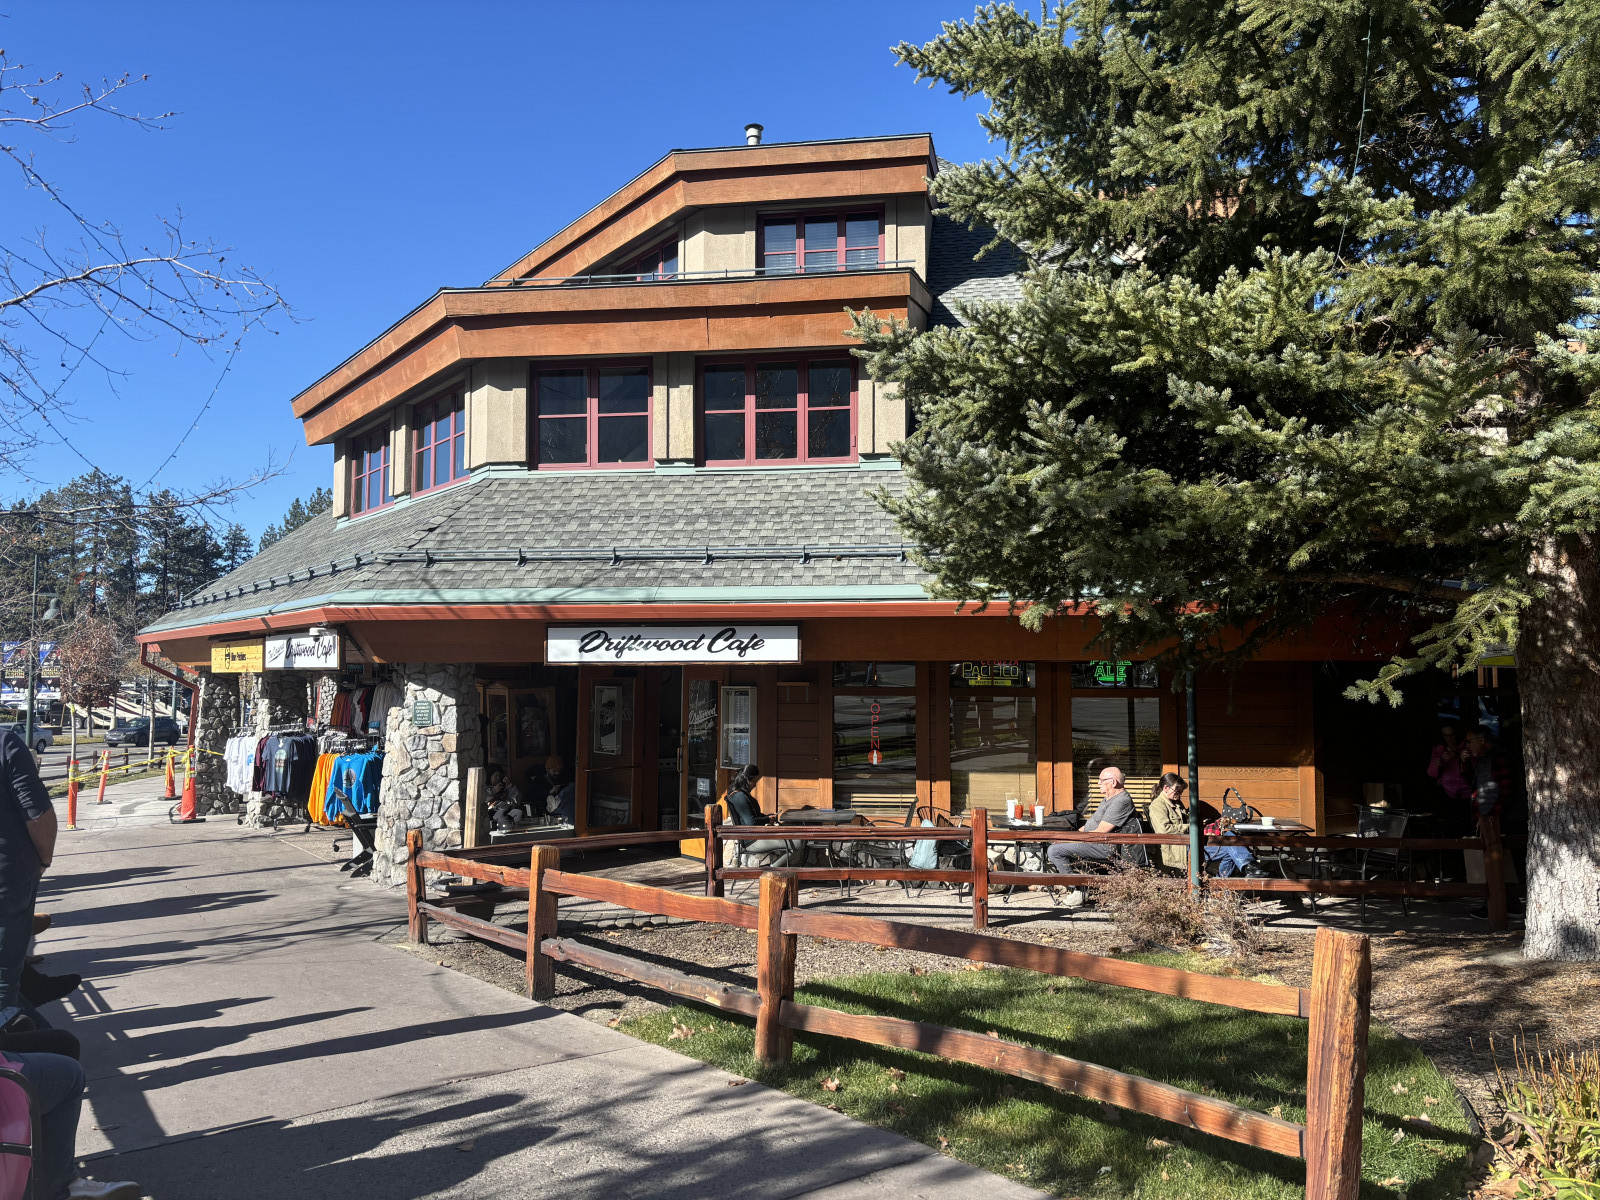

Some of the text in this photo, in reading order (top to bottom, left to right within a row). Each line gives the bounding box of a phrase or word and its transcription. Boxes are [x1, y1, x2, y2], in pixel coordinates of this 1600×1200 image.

[578, 627, 765, 659] Driftwood Cafe
[1093, 665, 1127, 678] ALE
[870, 703, 881, 750] OPEN
